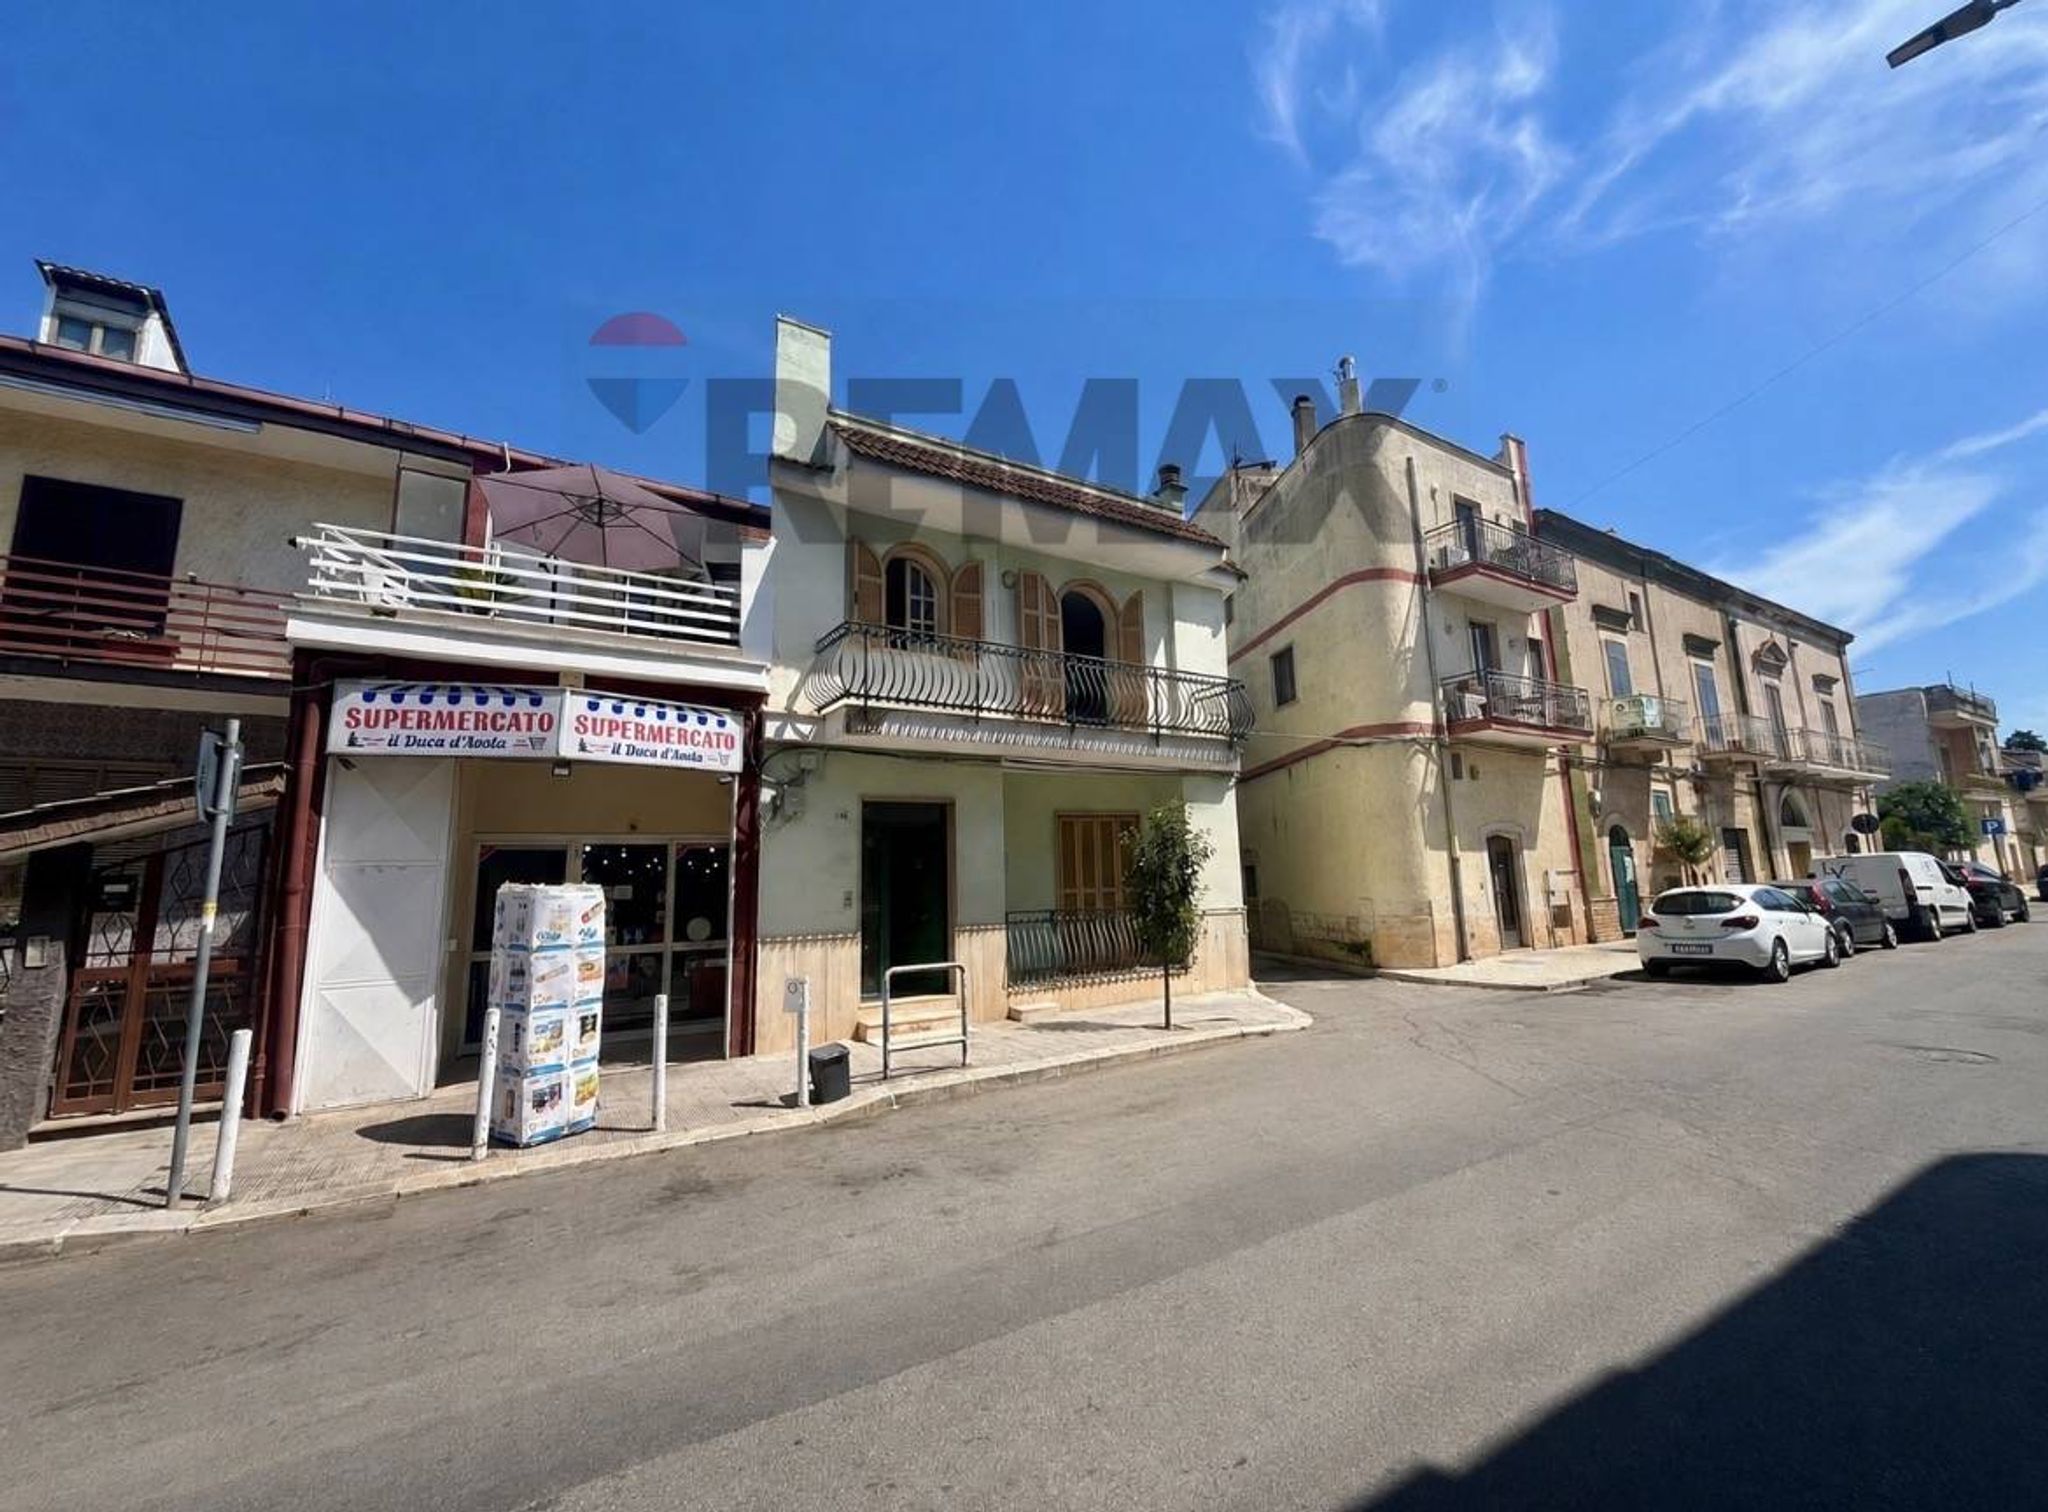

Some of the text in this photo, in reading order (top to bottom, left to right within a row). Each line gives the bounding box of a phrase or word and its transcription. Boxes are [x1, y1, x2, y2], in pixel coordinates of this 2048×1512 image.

[345, 706, 554, 733] SUPERMERCATO
[387, 734, 401, 748] il
[404, 735, 446, 749] Duca
[574, 714, 735, 751] SUPERMERCATO
[611, 742, 621, 755] il
[625, 744, 658, 760] Duca
[1986, 821, 1999, 833] P
